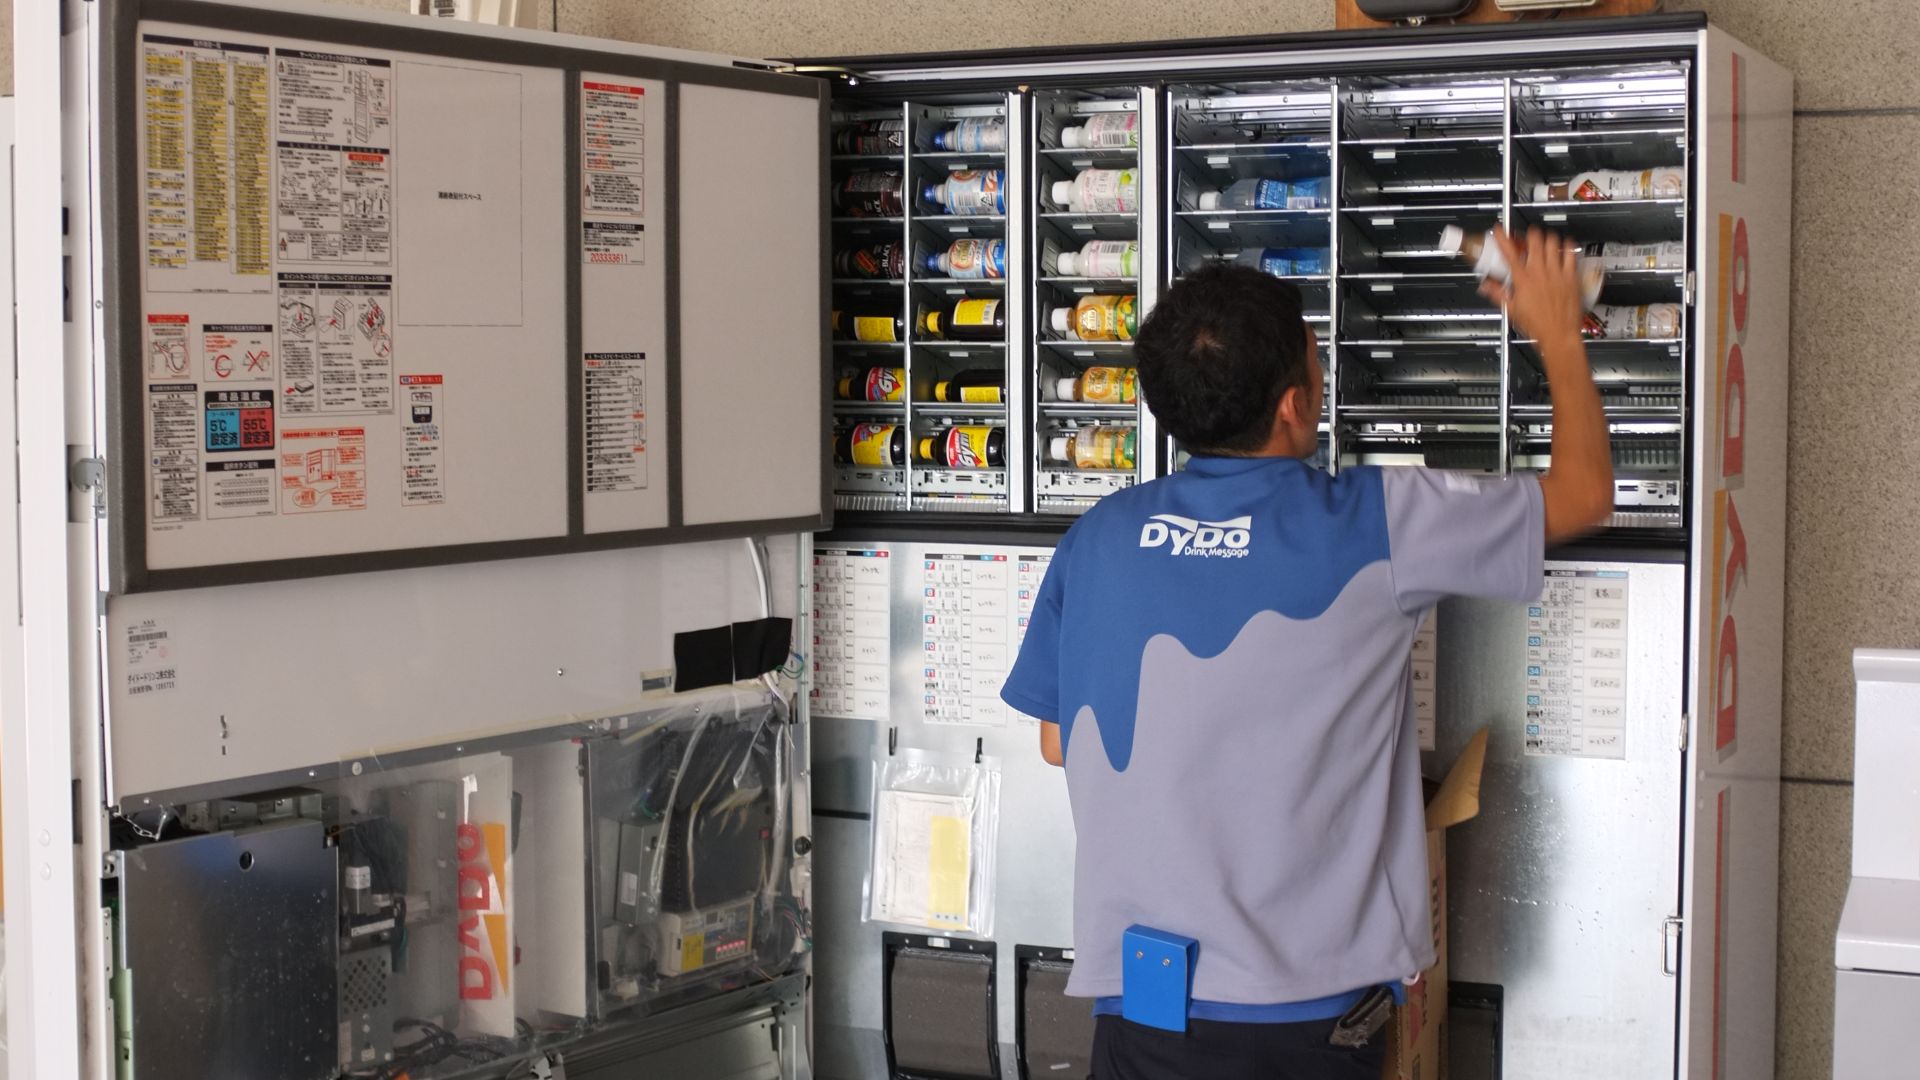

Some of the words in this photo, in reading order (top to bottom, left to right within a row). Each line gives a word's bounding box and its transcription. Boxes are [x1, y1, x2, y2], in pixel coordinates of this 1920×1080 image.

[1139, 516, 1252, 556] DyDo
[1184, 545, 1209, 558] Drink
[1208, 547, 1250, 559] Message
[1529, 608, 1541, 617] 32
[1529, 637, 1541, 646] 33
[1528, 666, 1540, 675] 34
[1527, 696, 1539, 705] 35
